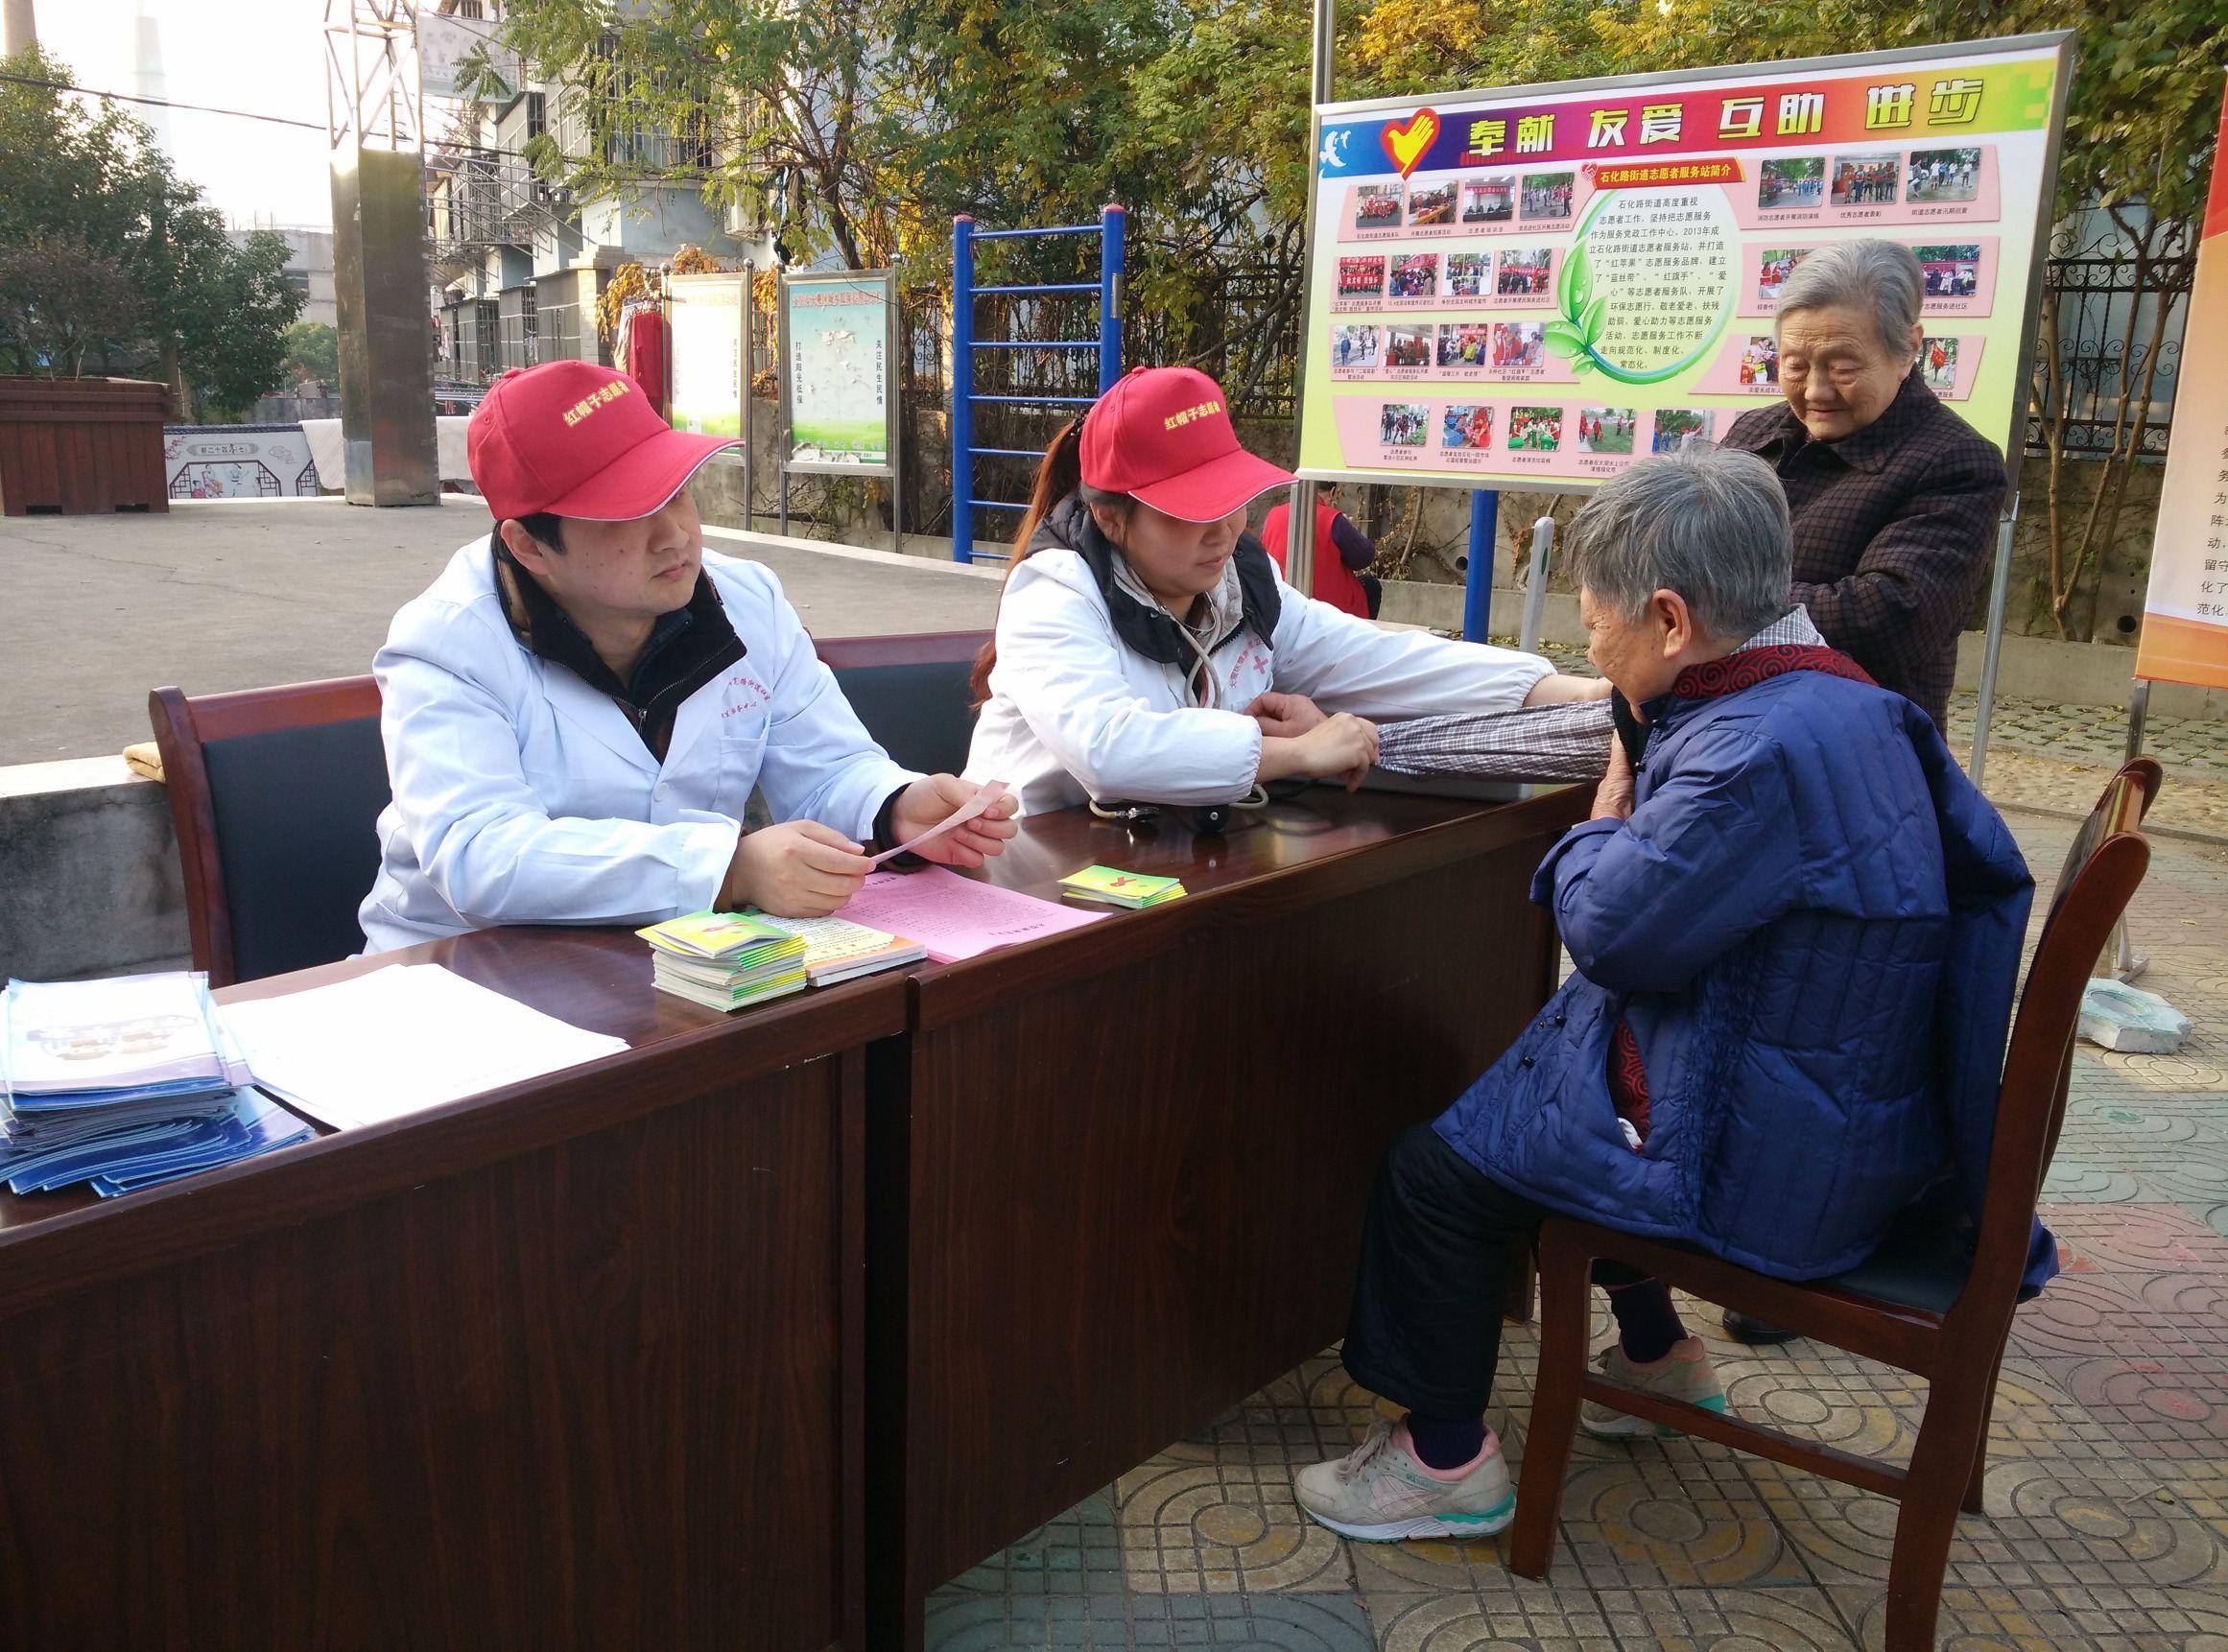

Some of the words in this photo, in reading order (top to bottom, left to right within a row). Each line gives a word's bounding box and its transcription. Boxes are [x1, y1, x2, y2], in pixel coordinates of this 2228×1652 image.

[1468, 113, 1556, 156] 奉献
[1587, 103, 1684, 149] 友爱
[1718, 92, 1825, 140] 互助
[1865, 79, 1985, 131] 进步
[1600, 163, 1732, 183] 石化路街道志愿者服务站简介
[1618, 196, 1698, 209] 石化路街道高度重视
[2214, 491, 2227, 505] 为
[2210, 514, 2228, 528] 阵
[2200, 579, 2228, 594] 化了
